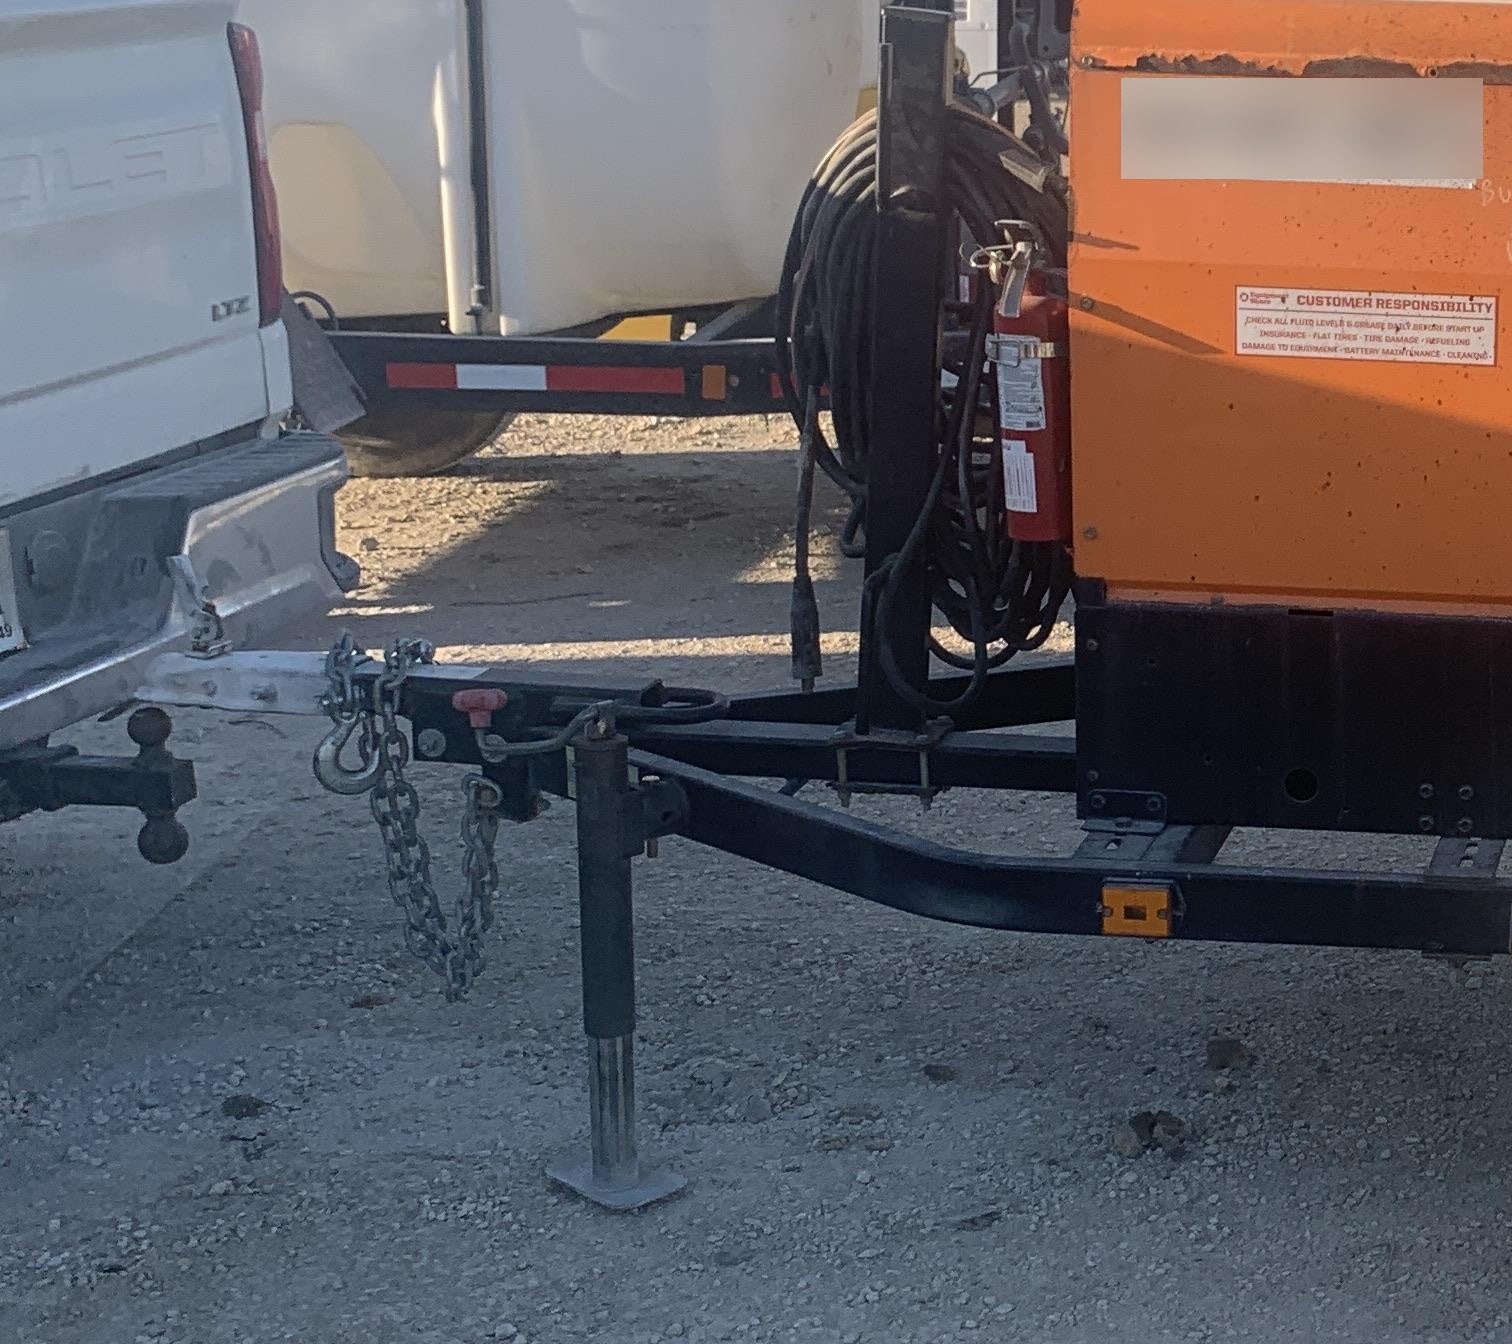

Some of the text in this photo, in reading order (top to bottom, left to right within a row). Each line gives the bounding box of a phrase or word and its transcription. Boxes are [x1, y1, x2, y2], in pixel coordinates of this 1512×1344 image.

[212, 295, 251, 322] LTZ
[1297, 295, 1494, 314] CUSTOMER RESPONSIBILITY
[1246, 316, 1272, 325] CHECK
[1274, 317, 1288, 325] ALL
[1290, 318, 1314, 327] FLUID
[1316, 319, 1345, 328] LEVELS
[1412, 323, 1443, 332] BEFORE
[1446, 325, 1471, 333] START
[1260, 330, 1471, 346] INSURANCE FLAT TIRES TIRE DAMAGE REFUELING
[1242, 341, 1276, 351] DAMAGE
[1278, 343, 1288, 351] TO
[1290, 344, 1338, 354] EQUIPMENT
[1344, 346, 1379, 355] BATTERY
[1382, 348, 1441, 358] MAINTENANCE
